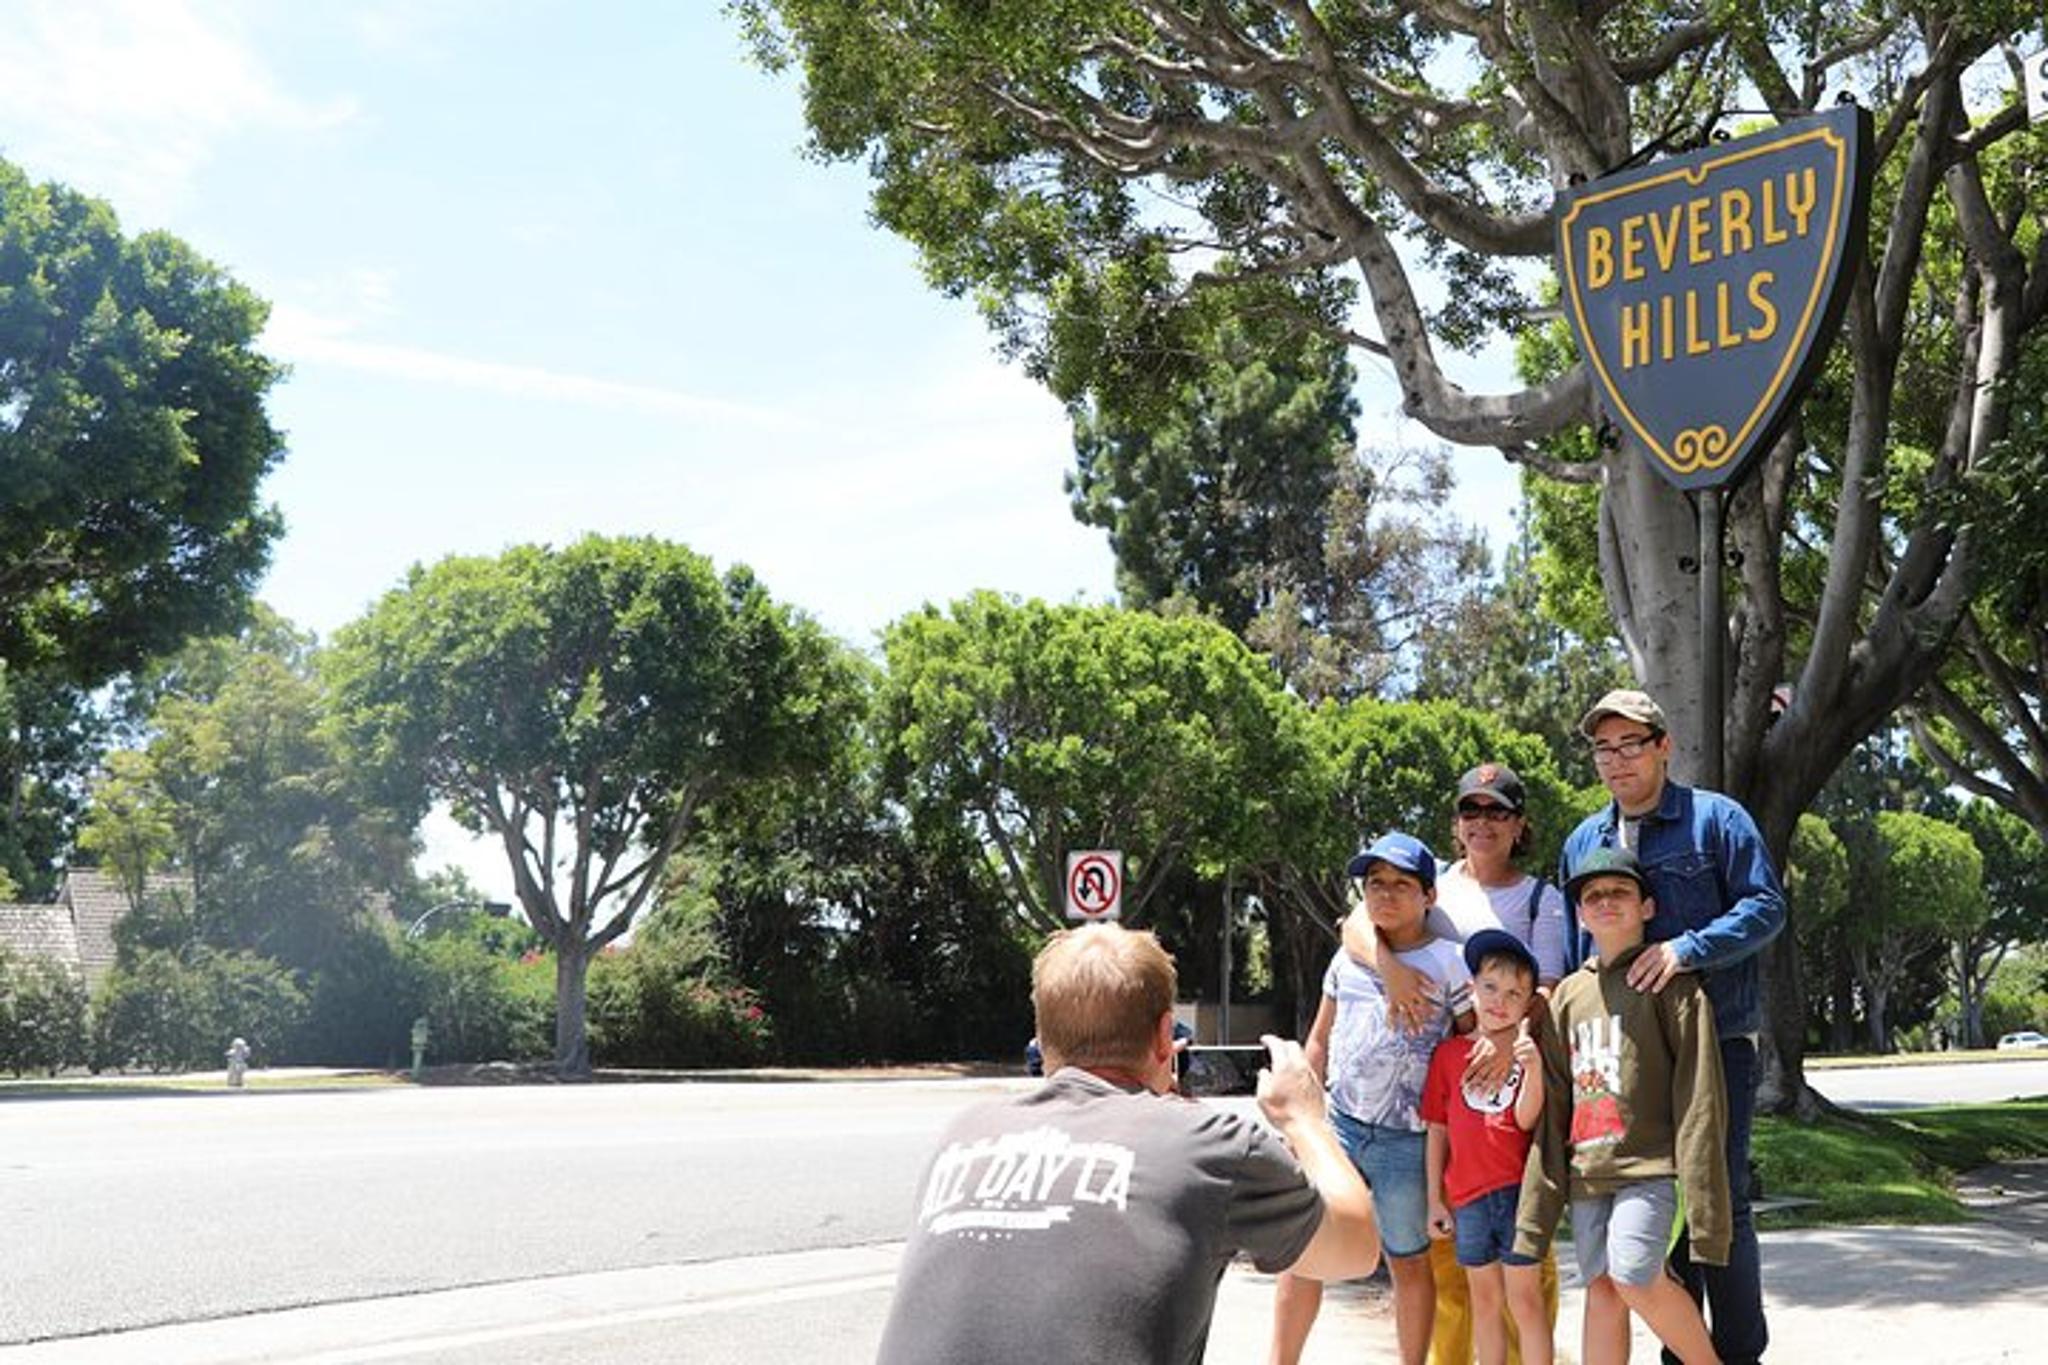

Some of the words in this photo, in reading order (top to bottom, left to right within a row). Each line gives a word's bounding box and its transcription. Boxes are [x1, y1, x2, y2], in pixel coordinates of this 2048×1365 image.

[1587, 168, 1816, 290] BEVERLY
[1622, 271, 1778, 369] HILLS
[975, 1138, 1075, 1201] DAY
[1073, 1142, 1136, 1213] LA
